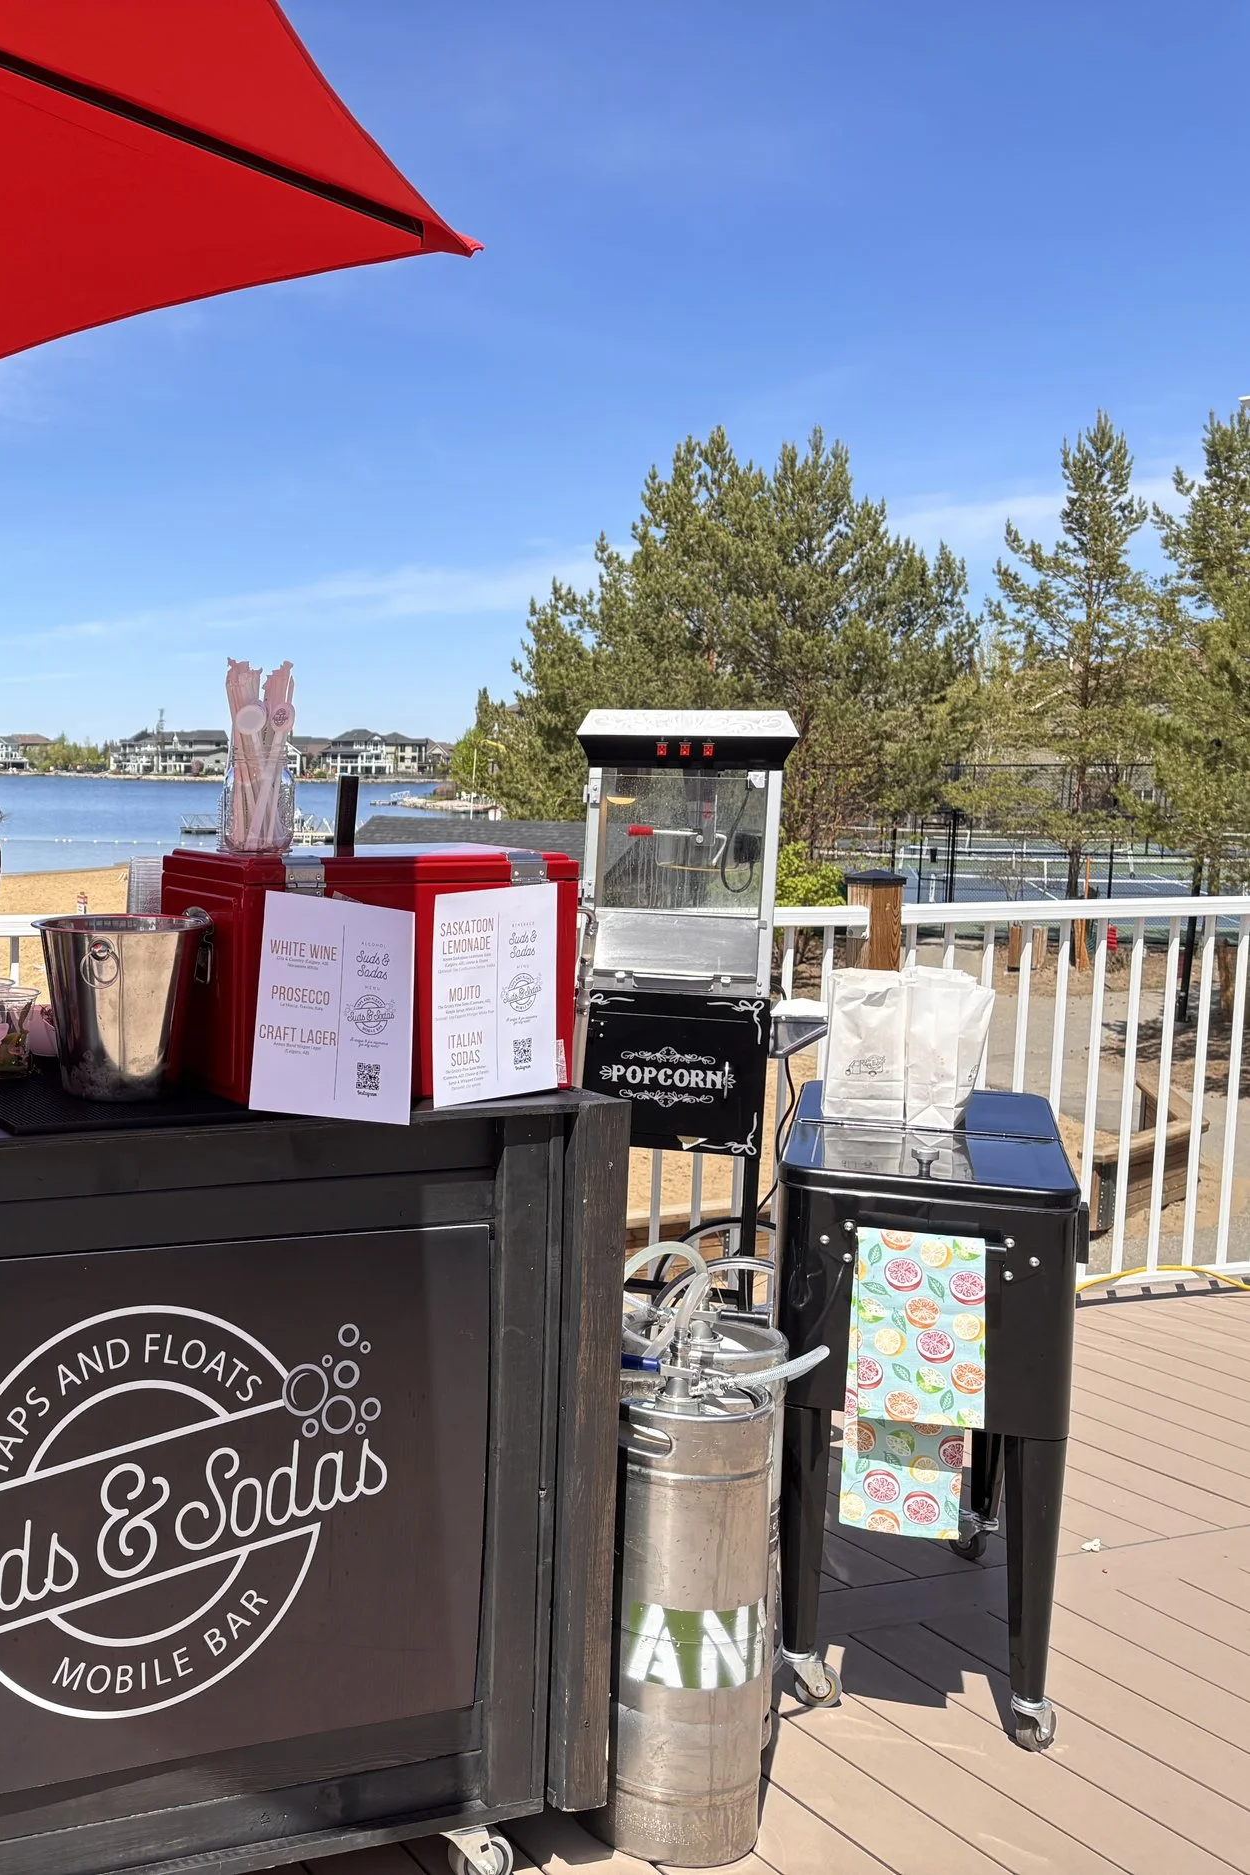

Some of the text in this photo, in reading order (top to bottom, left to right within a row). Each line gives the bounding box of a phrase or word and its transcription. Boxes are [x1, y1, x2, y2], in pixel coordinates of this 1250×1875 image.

[440, 917, 494, 937] SASKATOON
[509, 929, 537, 945] Suds &
[270, 939, 338, 961] WHITE WINE
[361, 941, 388, 949] ALCOHOL
[442, 935, 491, 955] LEMONADE
[510, 945, 535, 959] Sodas
[356, 950, 390, 966] Suds &
[357, 964, 388, 980] Sodas
[271, 985, 330, 1005] PROSECCO
[449, 985, 481, 1002] MOJITO
[259, 1023, 297, 1042] CRAFT
[300, 1028, 336, 1047] LAGER
[448, 1031, 483, 1050] ITALIAN
[451, 1049, 480, 1067] SODAS
[611, 1064, 723, 1089] POPCORN
[55, 1337, 131, 1394] AND
[143, 1332, 263, 1404] FLOATS
[96, 1462, 171, 1578] &
[174, 1438, 389, 1552] Sodas
[51, 1589, 269, 1696] MOBILE BAR
